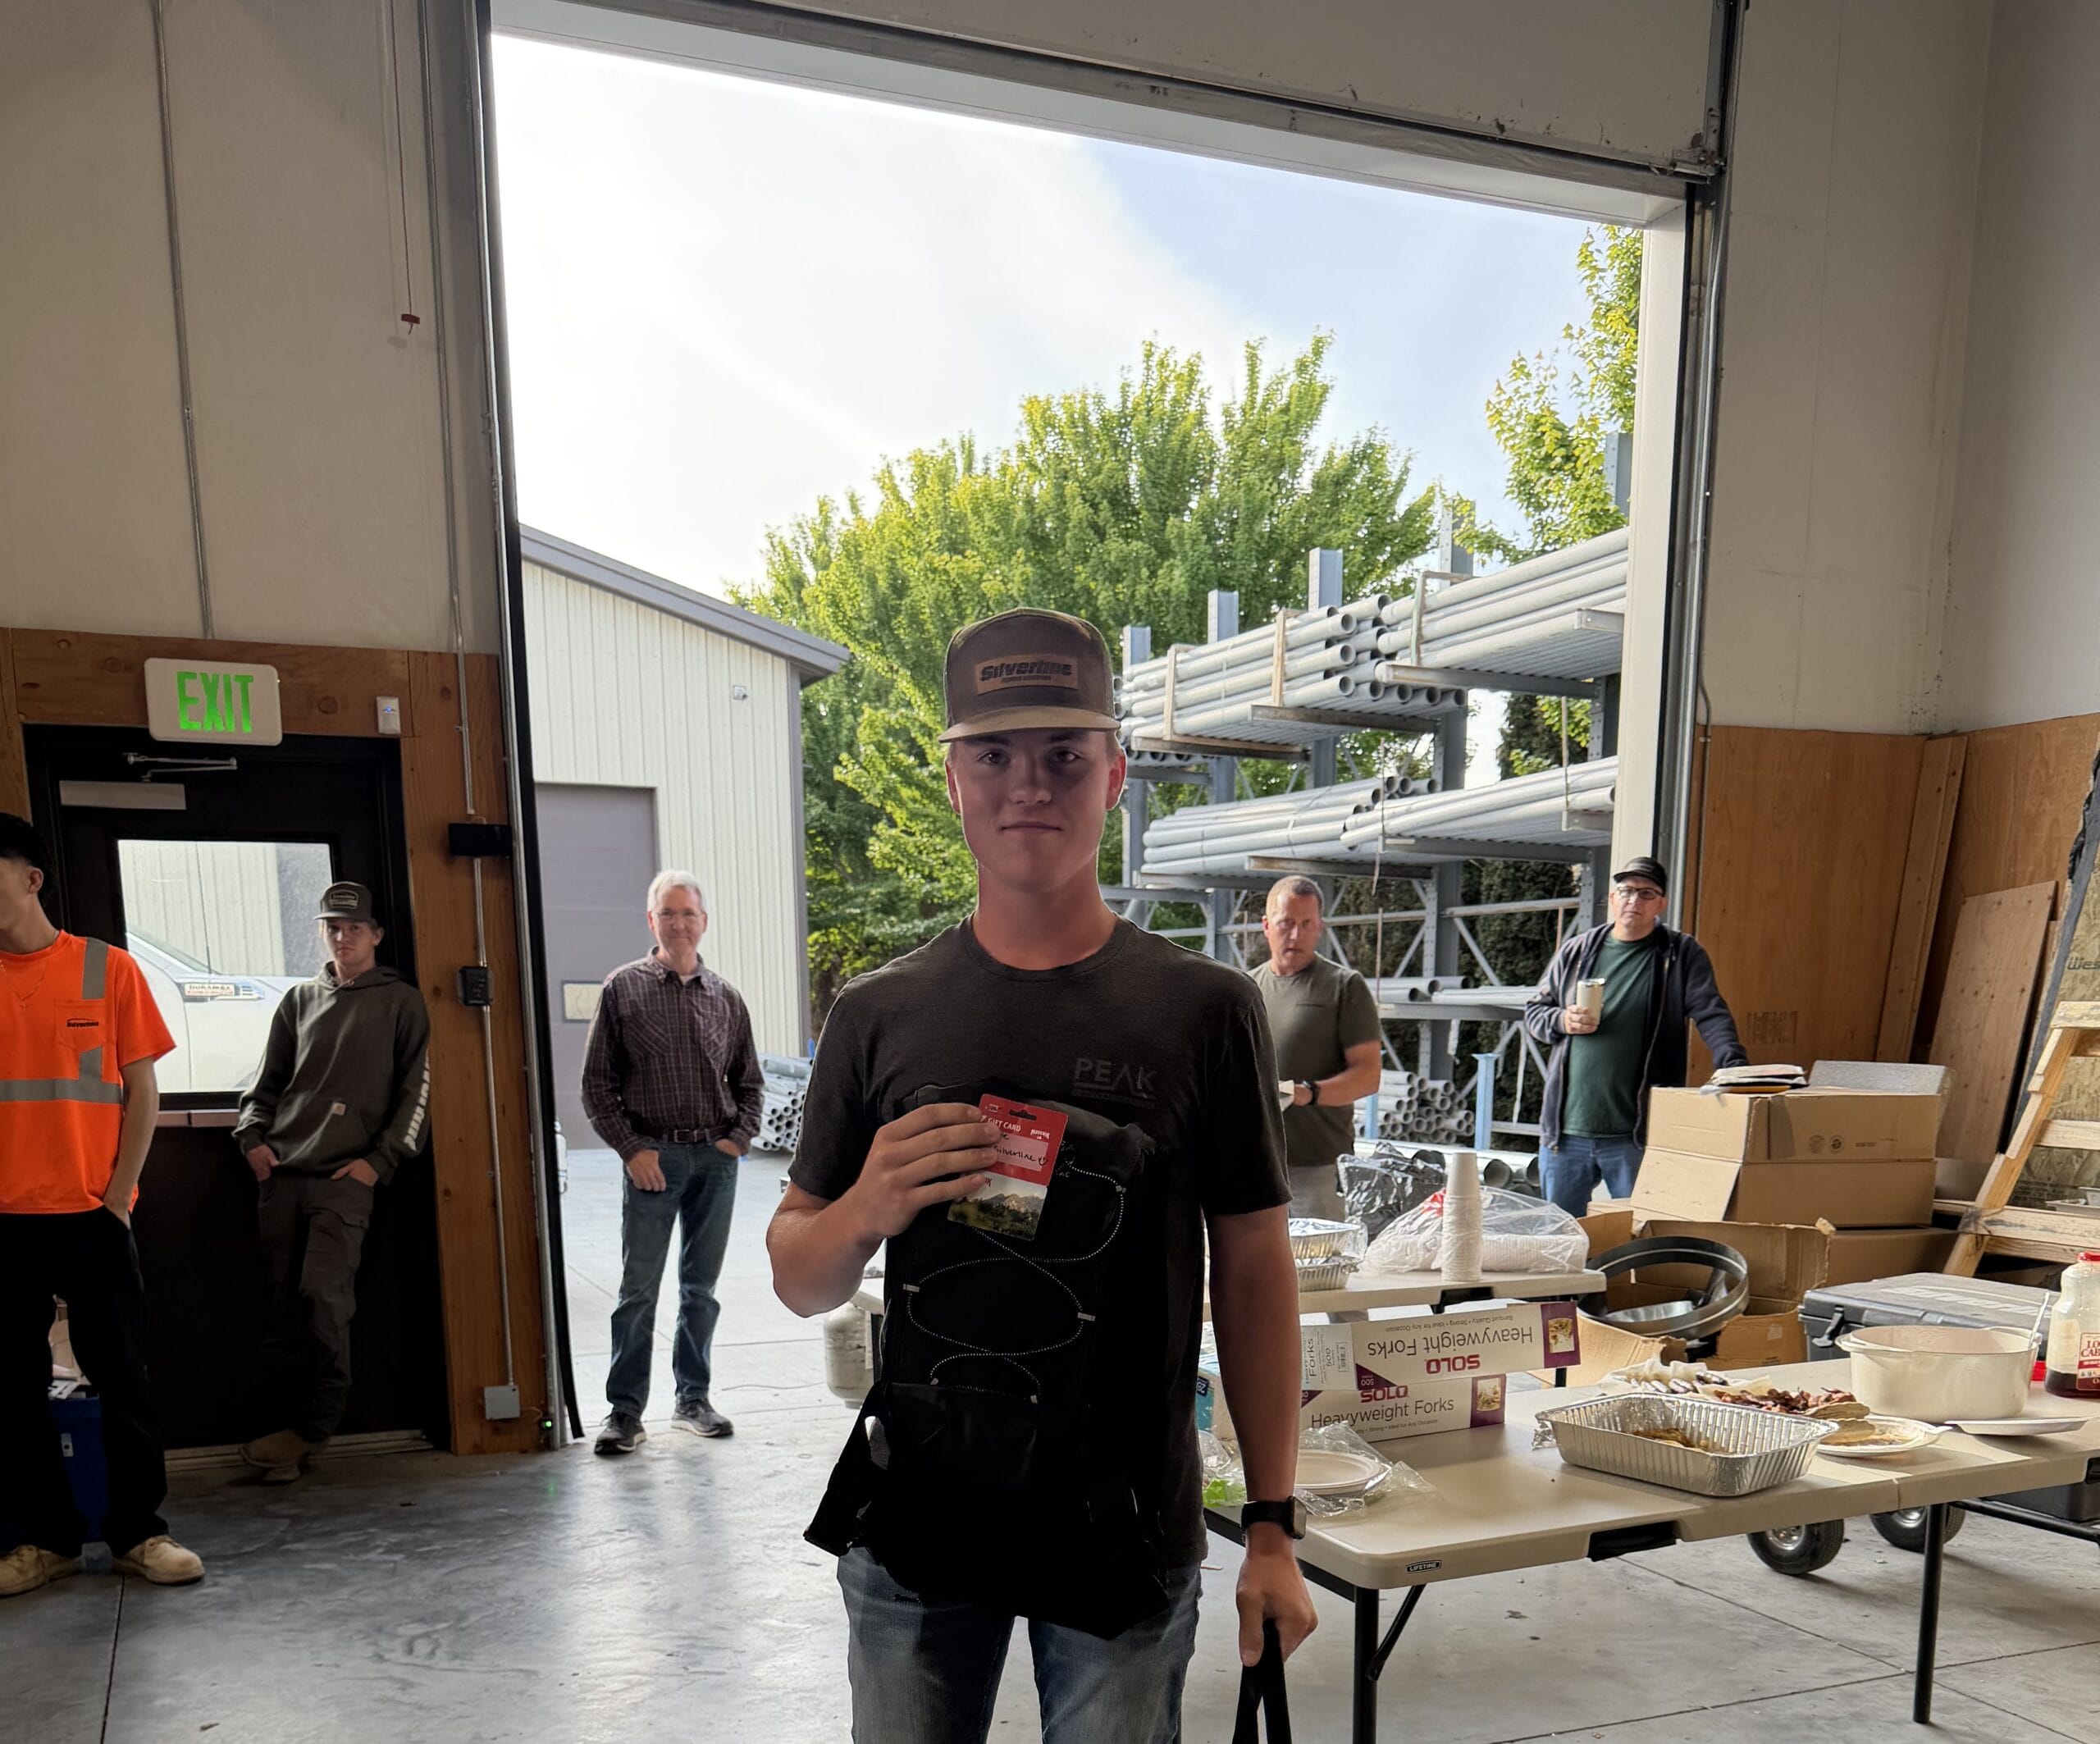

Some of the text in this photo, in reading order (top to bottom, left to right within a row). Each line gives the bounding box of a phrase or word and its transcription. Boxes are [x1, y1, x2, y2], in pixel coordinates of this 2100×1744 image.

[176, 671, 254, 733] EXIT
[1074, 1057, 1157, 1093] PEAK
[1003, 1121, 1021, 1132] CARD
[1472, 1316, 1491, 1324] Quality
[1367, 1338, 1417, 1359] Forks
[1424, 1326, 1533, 1354] Heavyweight
[1307, 1338, 1317, 1376] Forks
[1426, 1354, 1480, 1374] SOLO
[1361, 1378, 1374, 1386] 500
[1360, 1385, 1409, 1404] SOLO
[1312, 1397, 1454, 1428] Heavyweight Forks
